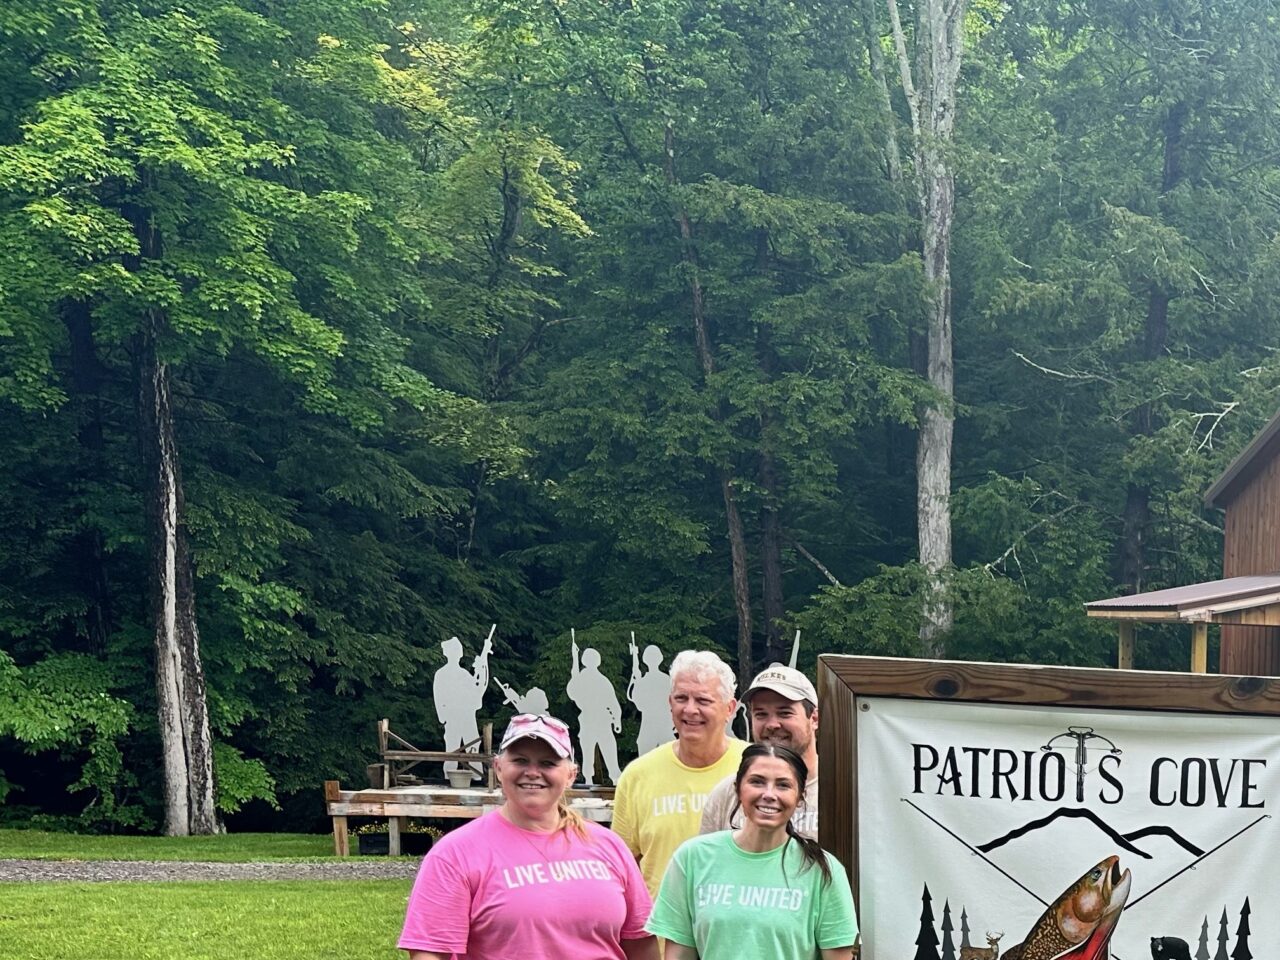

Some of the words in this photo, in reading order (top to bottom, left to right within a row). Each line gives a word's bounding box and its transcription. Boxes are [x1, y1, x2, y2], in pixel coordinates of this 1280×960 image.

[911, 743, 1124, 804] PATRIOTS
[1150, 757, 1267, 808] COVE
[654, 794, 687, 817] LIVE
[504, 862, 549, 889] LIVE
[549, 859, 612, 882] UNITED
[698, 884, 735, 907] LIVE
[739, 885, 804, 911] UNITED
